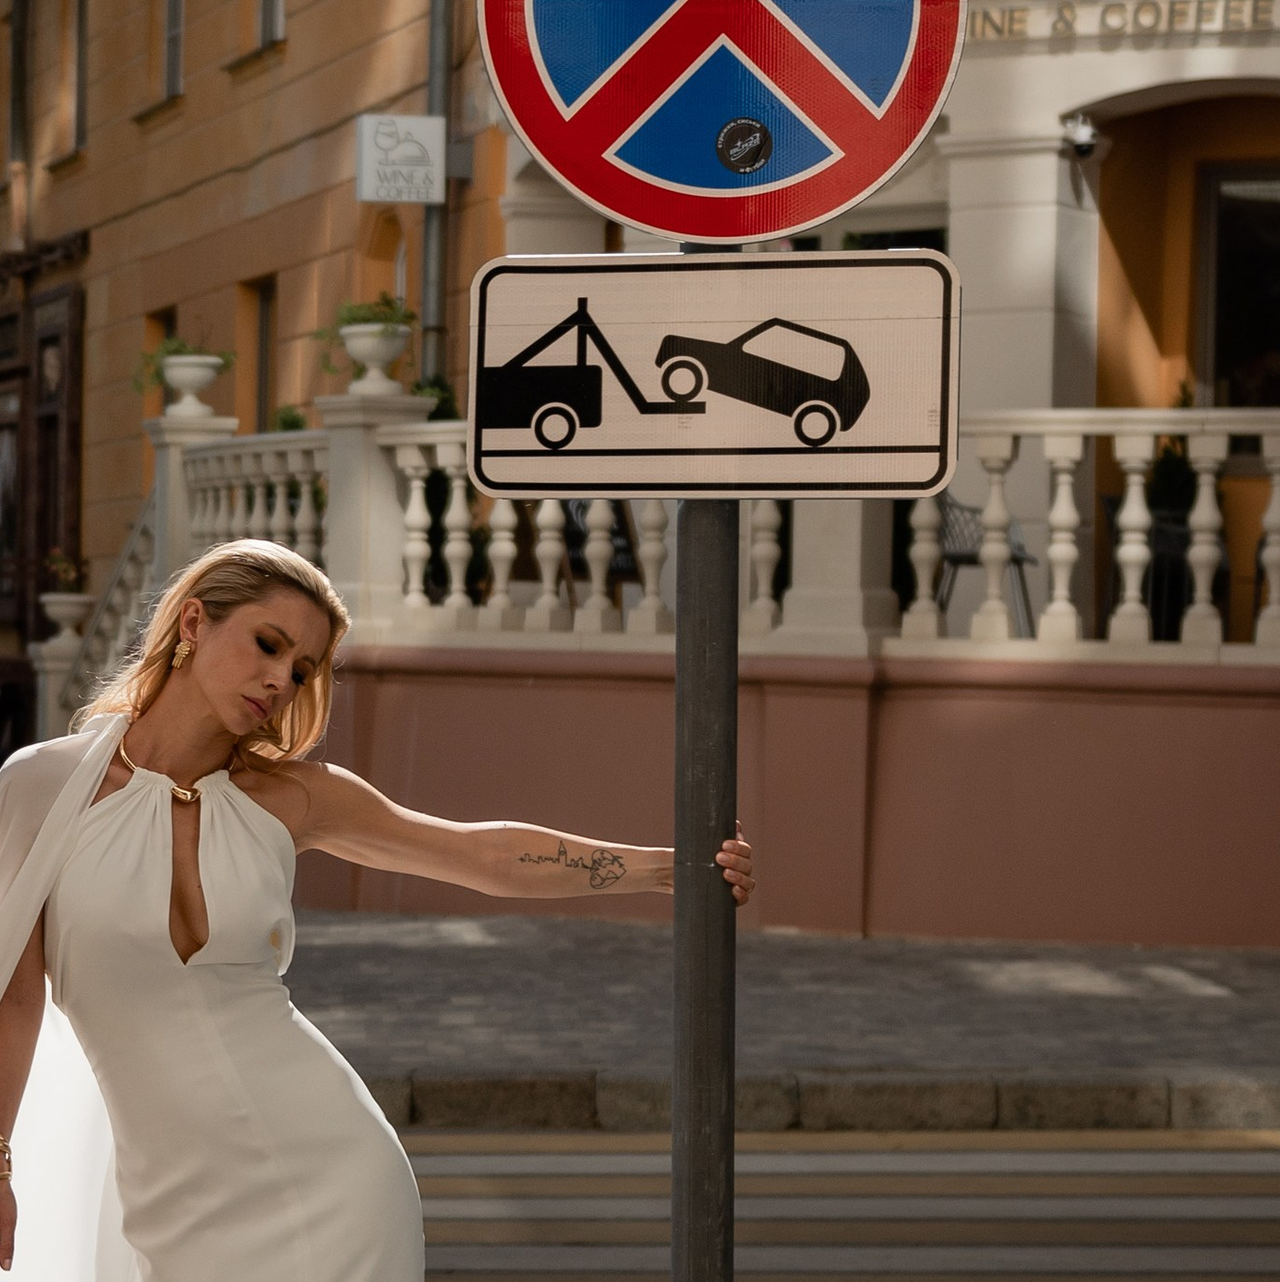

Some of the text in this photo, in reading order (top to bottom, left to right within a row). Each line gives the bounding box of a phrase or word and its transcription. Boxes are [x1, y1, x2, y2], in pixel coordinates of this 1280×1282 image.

[970, 6, 1028, 39] INE
[1052, 1, 1077, 36] &
[376, 169, 434, 185] WINE &
[376, 186, 430, 199] COFFEE
